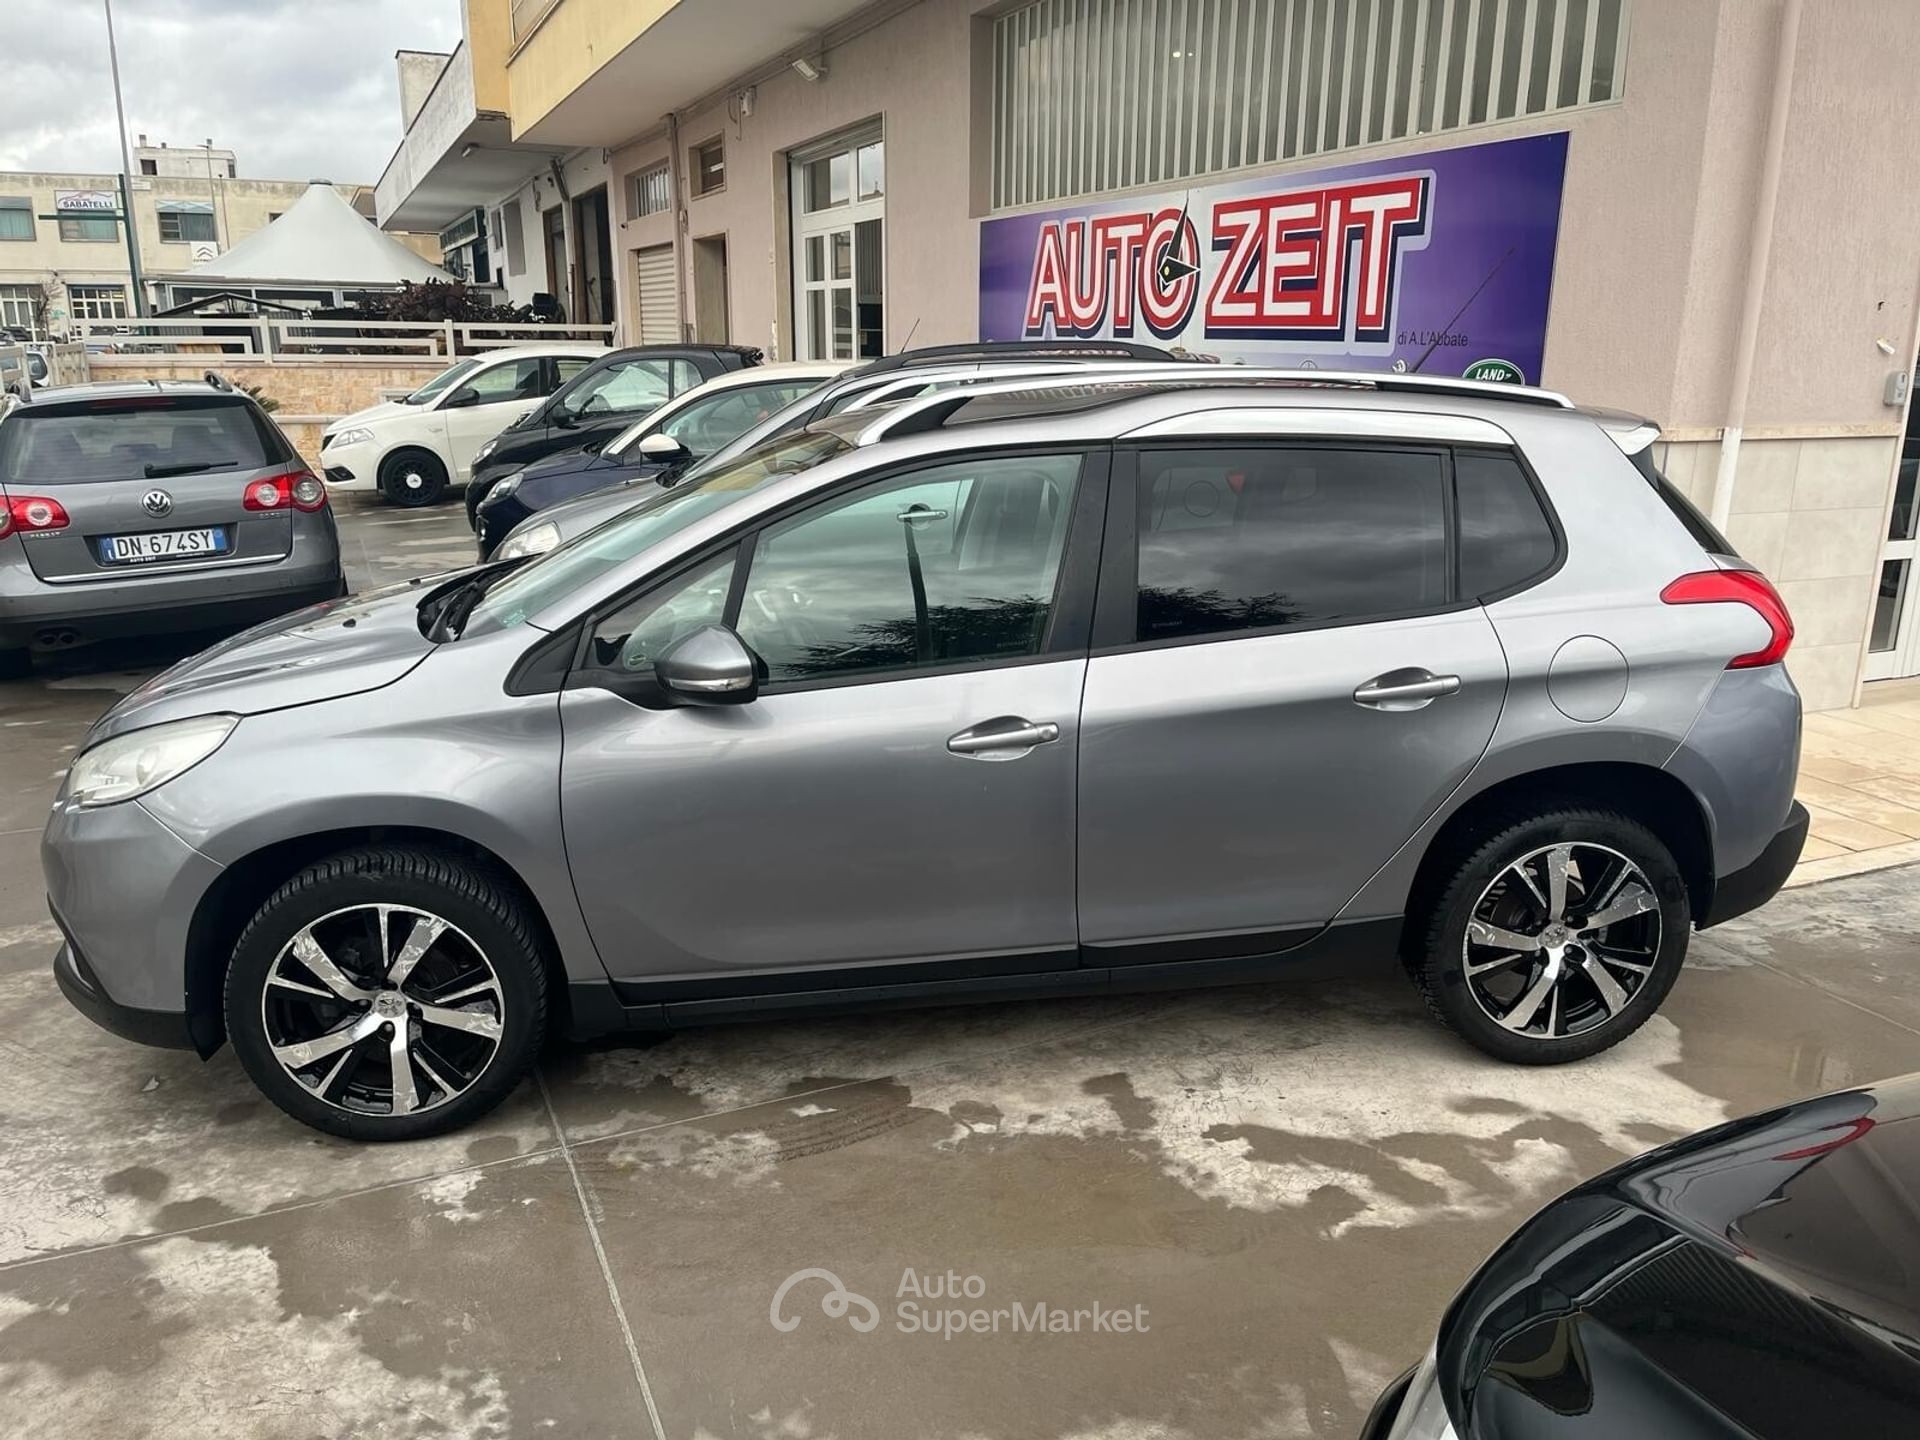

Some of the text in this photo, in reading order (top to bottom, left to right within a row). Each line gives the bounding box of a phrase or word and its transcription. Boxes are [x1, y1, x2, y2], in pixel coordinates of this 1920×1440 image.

[62, 199, 113, 209] SABATELLI
[1025, 177, 1430, 344] AUTO ZEIT
[1397, 331, 1407, 345] di
[1475, 368, 1506, 382] LAND
[116, 536, 143, 557] DN
